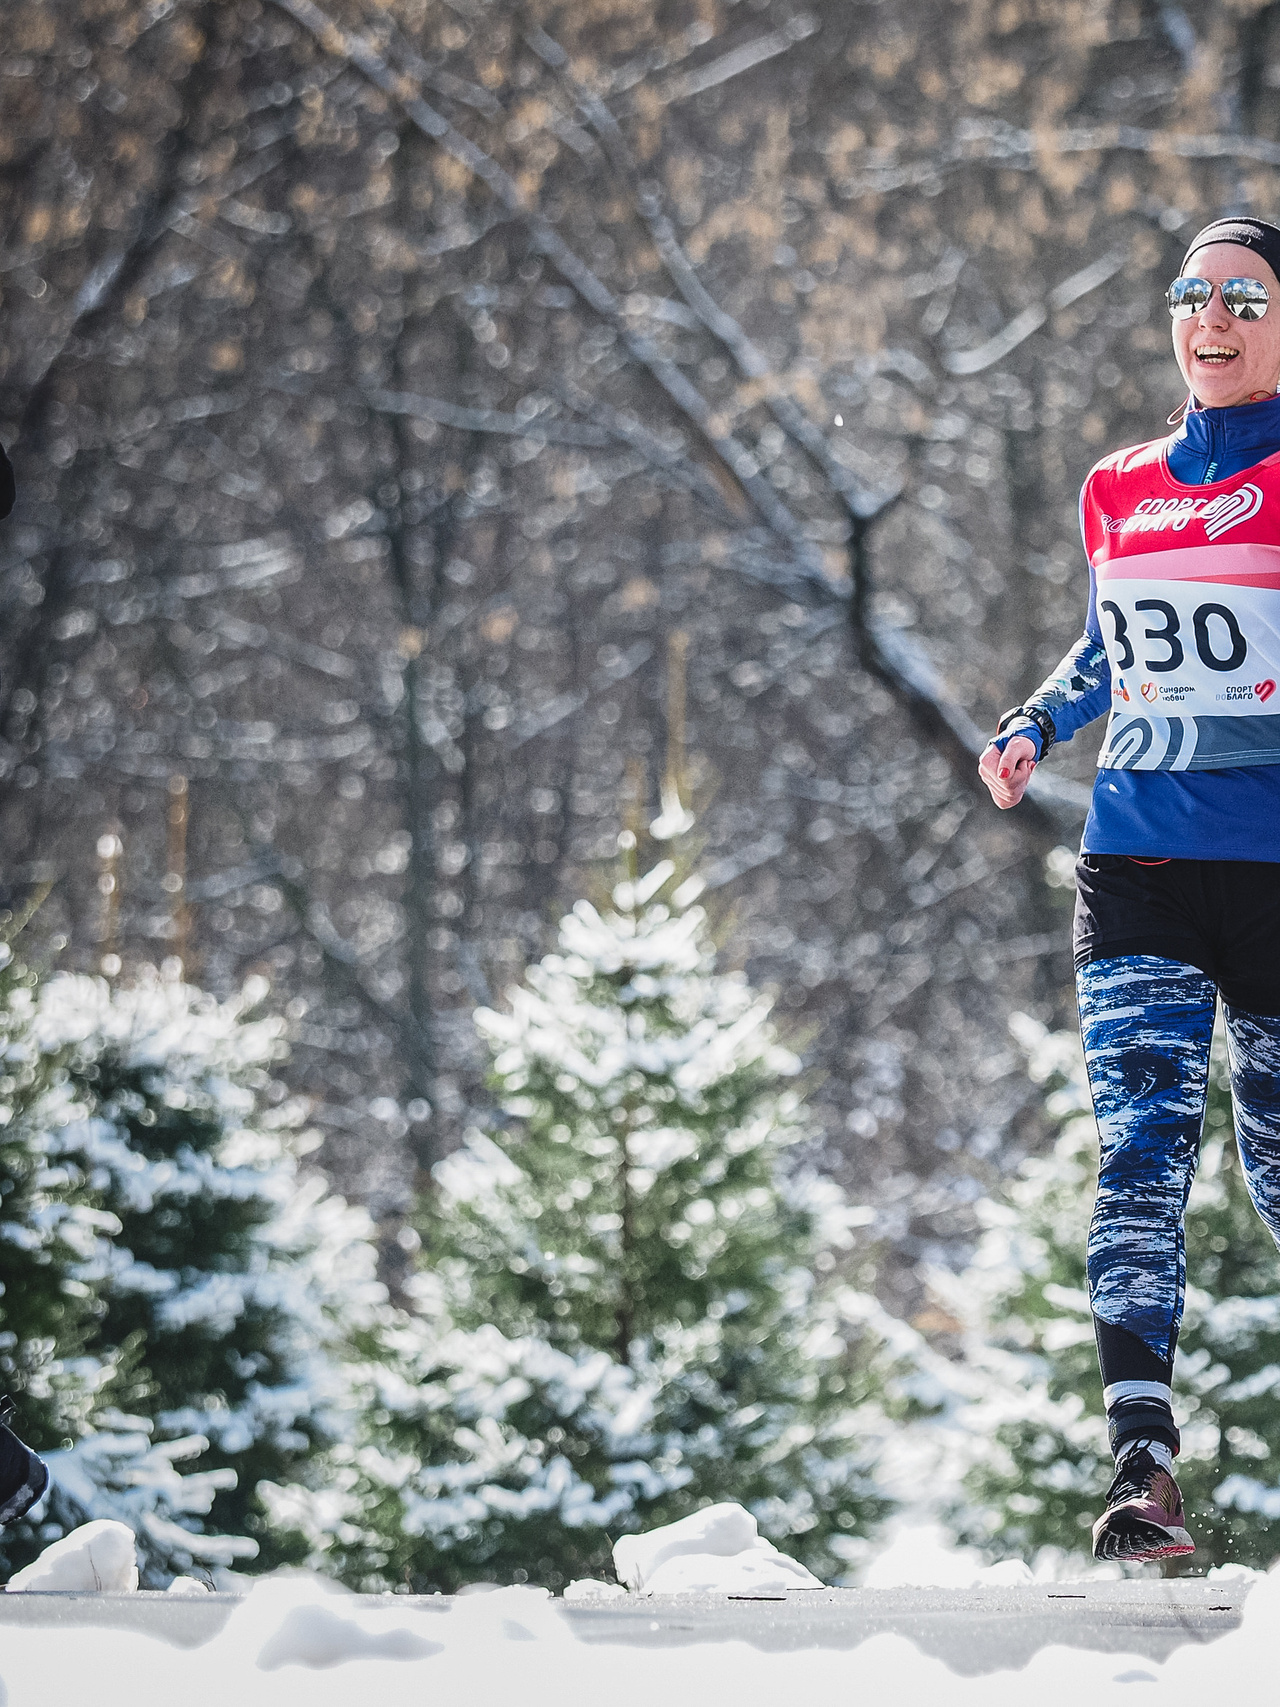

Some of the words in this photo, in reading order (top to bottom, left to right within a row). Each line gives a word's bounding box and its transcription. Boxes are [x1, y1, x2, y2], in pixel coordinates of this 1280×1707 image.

[1203, 461, 1218, 484] NIKE
[1134, 498, 1208, 515] СПОРТ
[1100, 599, 1248, 672] 330
[1161, 694, 1185, 702] юбви
[1226, 685, 1253, 694] СПОРТ
